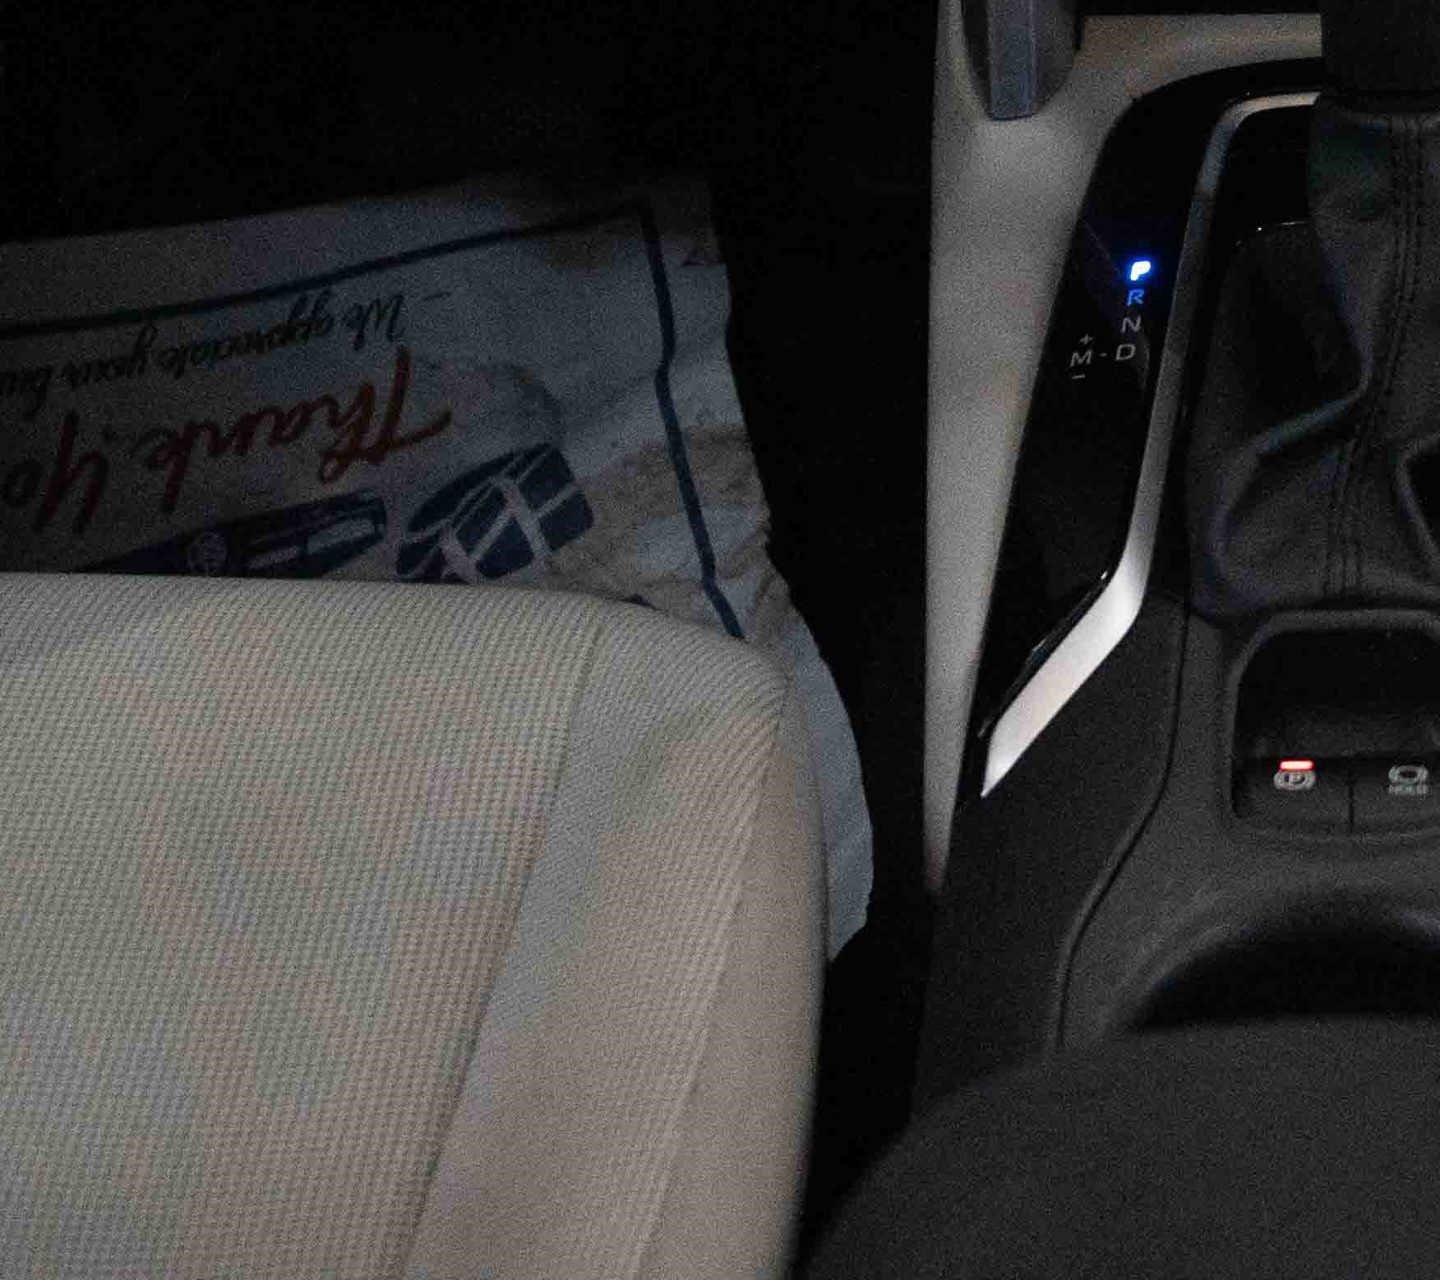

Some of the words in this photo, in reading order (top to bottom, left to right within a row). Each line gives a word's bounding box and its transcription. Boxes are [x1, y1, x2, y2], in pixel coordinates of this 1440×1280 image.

[1130, 260, 1151, 281] P
[1126, 288, 1145, 307] R
[343, 293, 407, 346] We
[1121, 315, 1141, 334] N
[156, 293, 335, 378] appreciate
[59, 324, 155, 388] your
[1069, 348, 1093, 368] M
[1115, 343, 1137, 361] D
[131, 346, 451, 513] Thank
